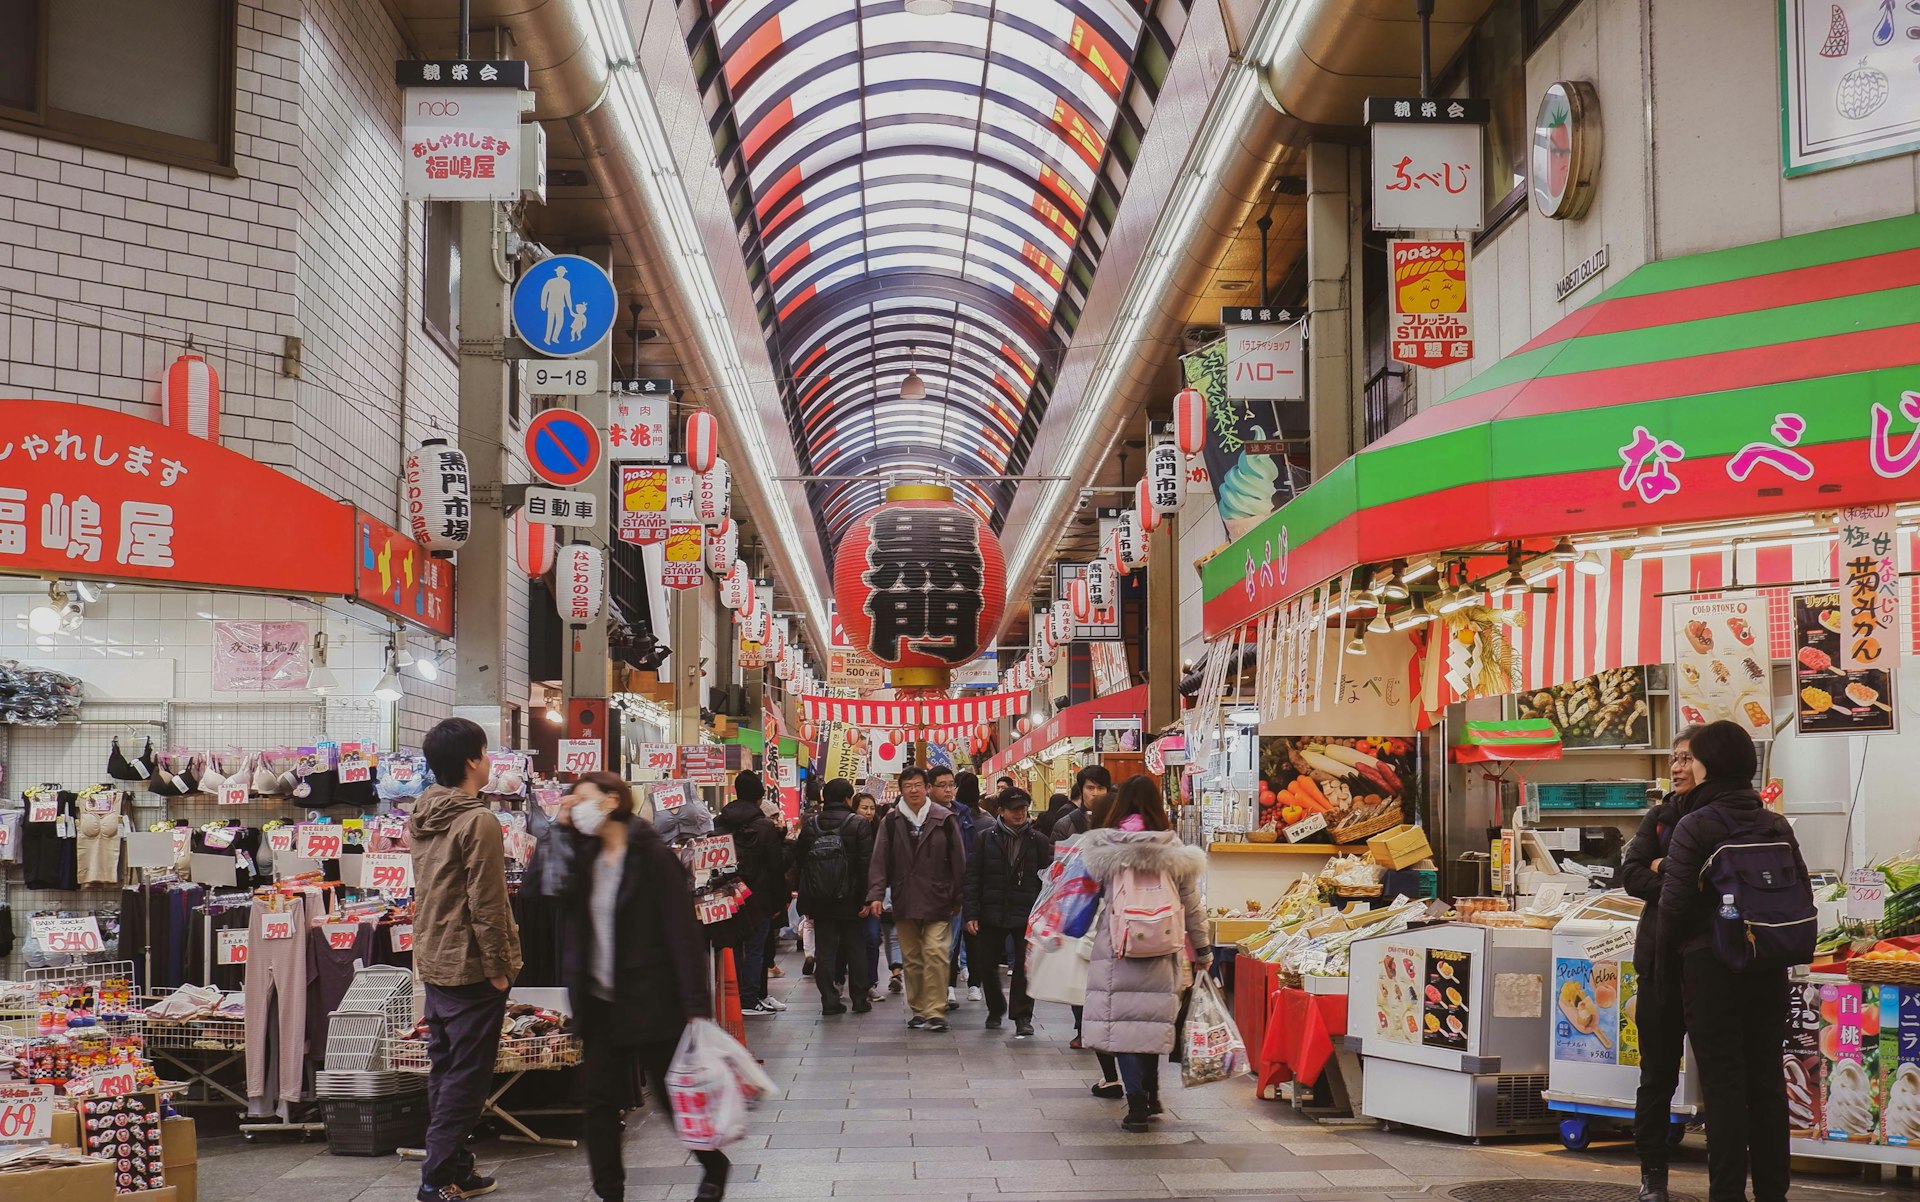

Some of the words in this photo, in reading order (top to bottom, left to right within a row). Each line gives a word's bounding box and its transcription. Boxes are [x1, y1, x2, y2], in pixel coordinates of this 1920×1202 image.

[423, 64, 498, 81] 親栄会
[1394, 101, 1465, 118] 親栄会
[412, 131, 511, 158] おしゃれします
[425, 155, 495, 179] 福嶋屋
[1396, 246, 1441, 263] クロモン
[1240, 309, 1291, 321] 親栄会
[1403, 314, 1459, 325] フレッシュ
[1397, 325, 1467, 339] STAMP
[1398, 342, 1468, 358] 加盟店
[1235, 362, 1294, 381] ハロー
[1619, 391, 1920, 503] なべじ
[1155, 450, 1177, 506] 黒門市場
[407, 455, 431, 544] なにわの台所
[439, 451, 470, 542] 黒門市場
[529, 496, 593, 519] 自動車
[627, 511, 662, 519] フレッシュ
[623, 519, 666, 527] STAMP
[623, 529, 668, 539] 加盟店
[1119, 514, 1133, 563] 黒門市場
[665, 567, 701, 575] STAMP
[1245, 525, 1288, 602] なべじ
[571, 550, 589, 619] なにわの台所
[1089, 563, 1103, 605] 黒門市場
[1692, 605, 1711, 615] COLD
[1712, 604, 1735, 613] STONE
[1846, 556, 1888, 661] 菊みかん
[1062, 604, 1071, 639] ほんまもん
[565, 751, 597, 772] 599
[648, 752, 673, 768] 399
[226, 790, 245, 803] 199
[661, 794, 683, 808] 399
[307, 835, 340, 858] 599
[701, 848, 729, 868] 199
[373, 866, 405, 887] 599
[705, 904, 727, 923] 199
[48, 931, 98, 951] 540
[330, 932, 356, 948] 599
[1587, 943, 1605, 952] Please
[1557, 961, 1587, 980] Peach
[1841, 994, 1860, 1045] 白桃
[99, 1074, 133, 1097] 430
